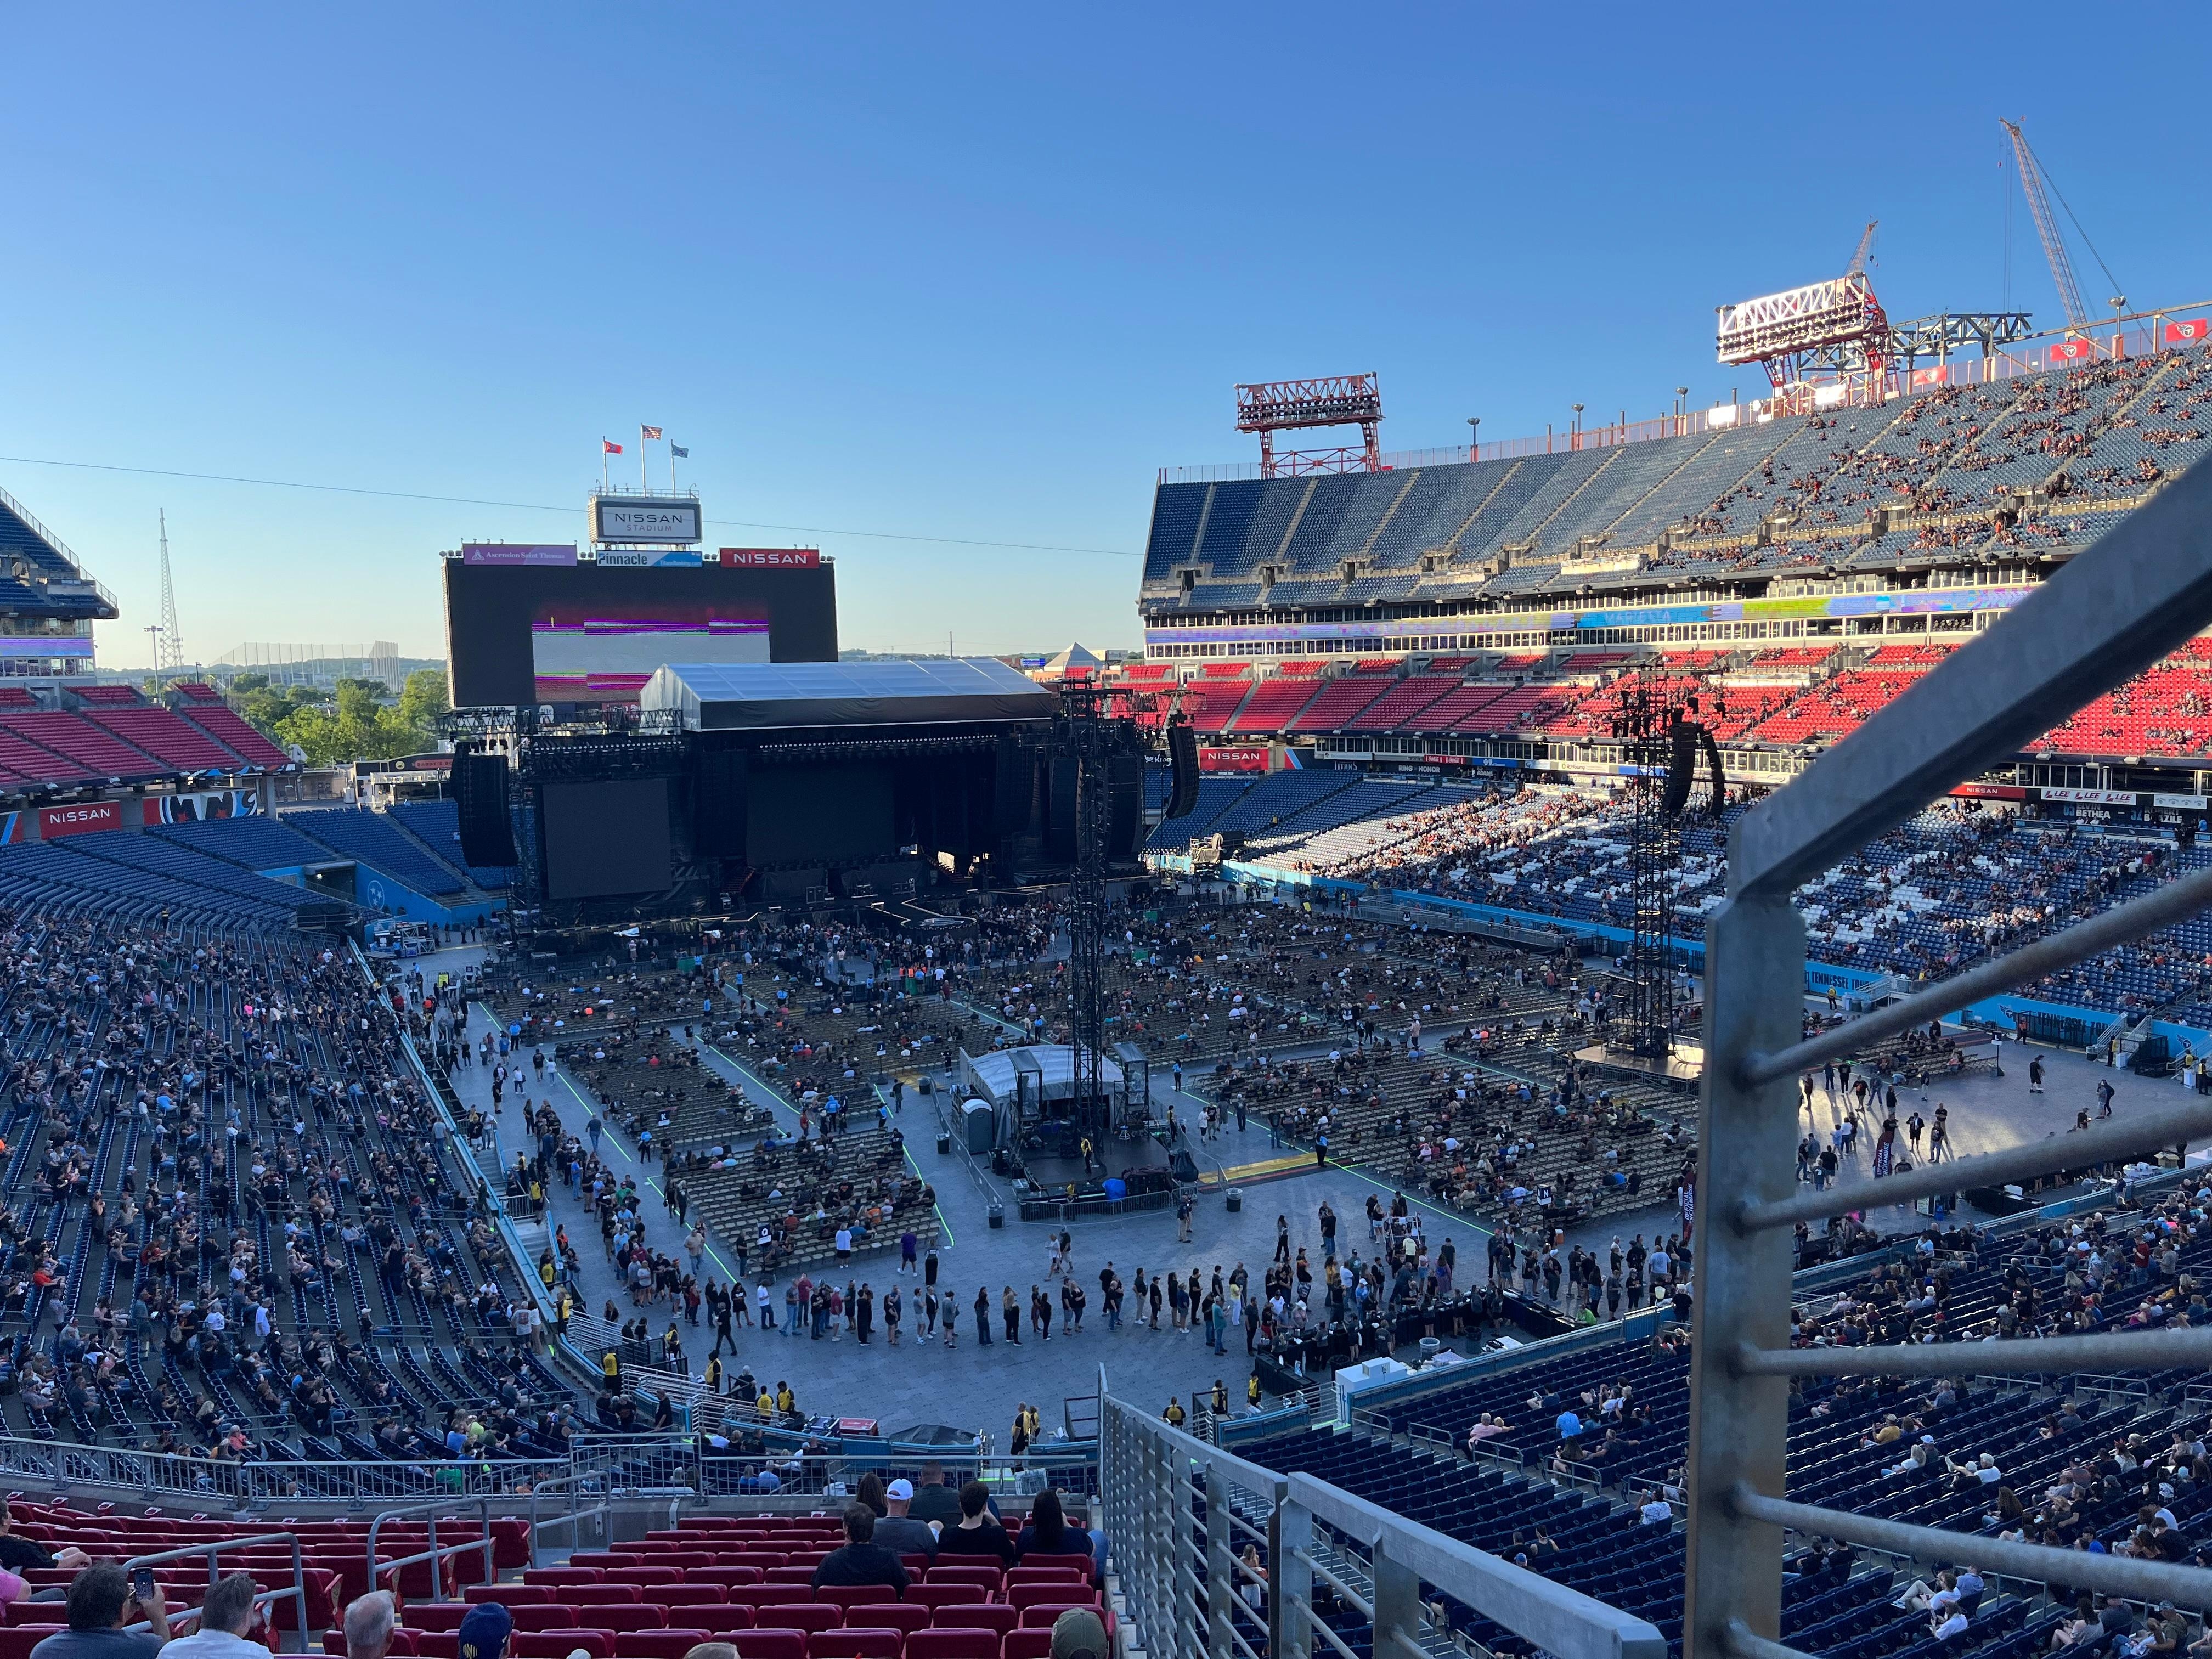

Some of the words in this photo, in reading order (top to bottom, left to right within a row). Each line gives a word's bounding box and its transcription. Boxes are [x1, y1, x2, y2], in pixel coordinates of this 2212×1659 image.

[615, 514, 682, 523] NISSAN
[598, 552, 647, 565] Pinnacle
[733, 553, 806, 564] NISSAN
[1207, 752, 1260, 760] NISSAN
[50, 808, 110, 824] NISSAN
[2076, 810, 2111, 819] BETHEA
[1812, 971, 1849, 990] TENNESSEE
[1543, 1189, 1549, 1198] N
